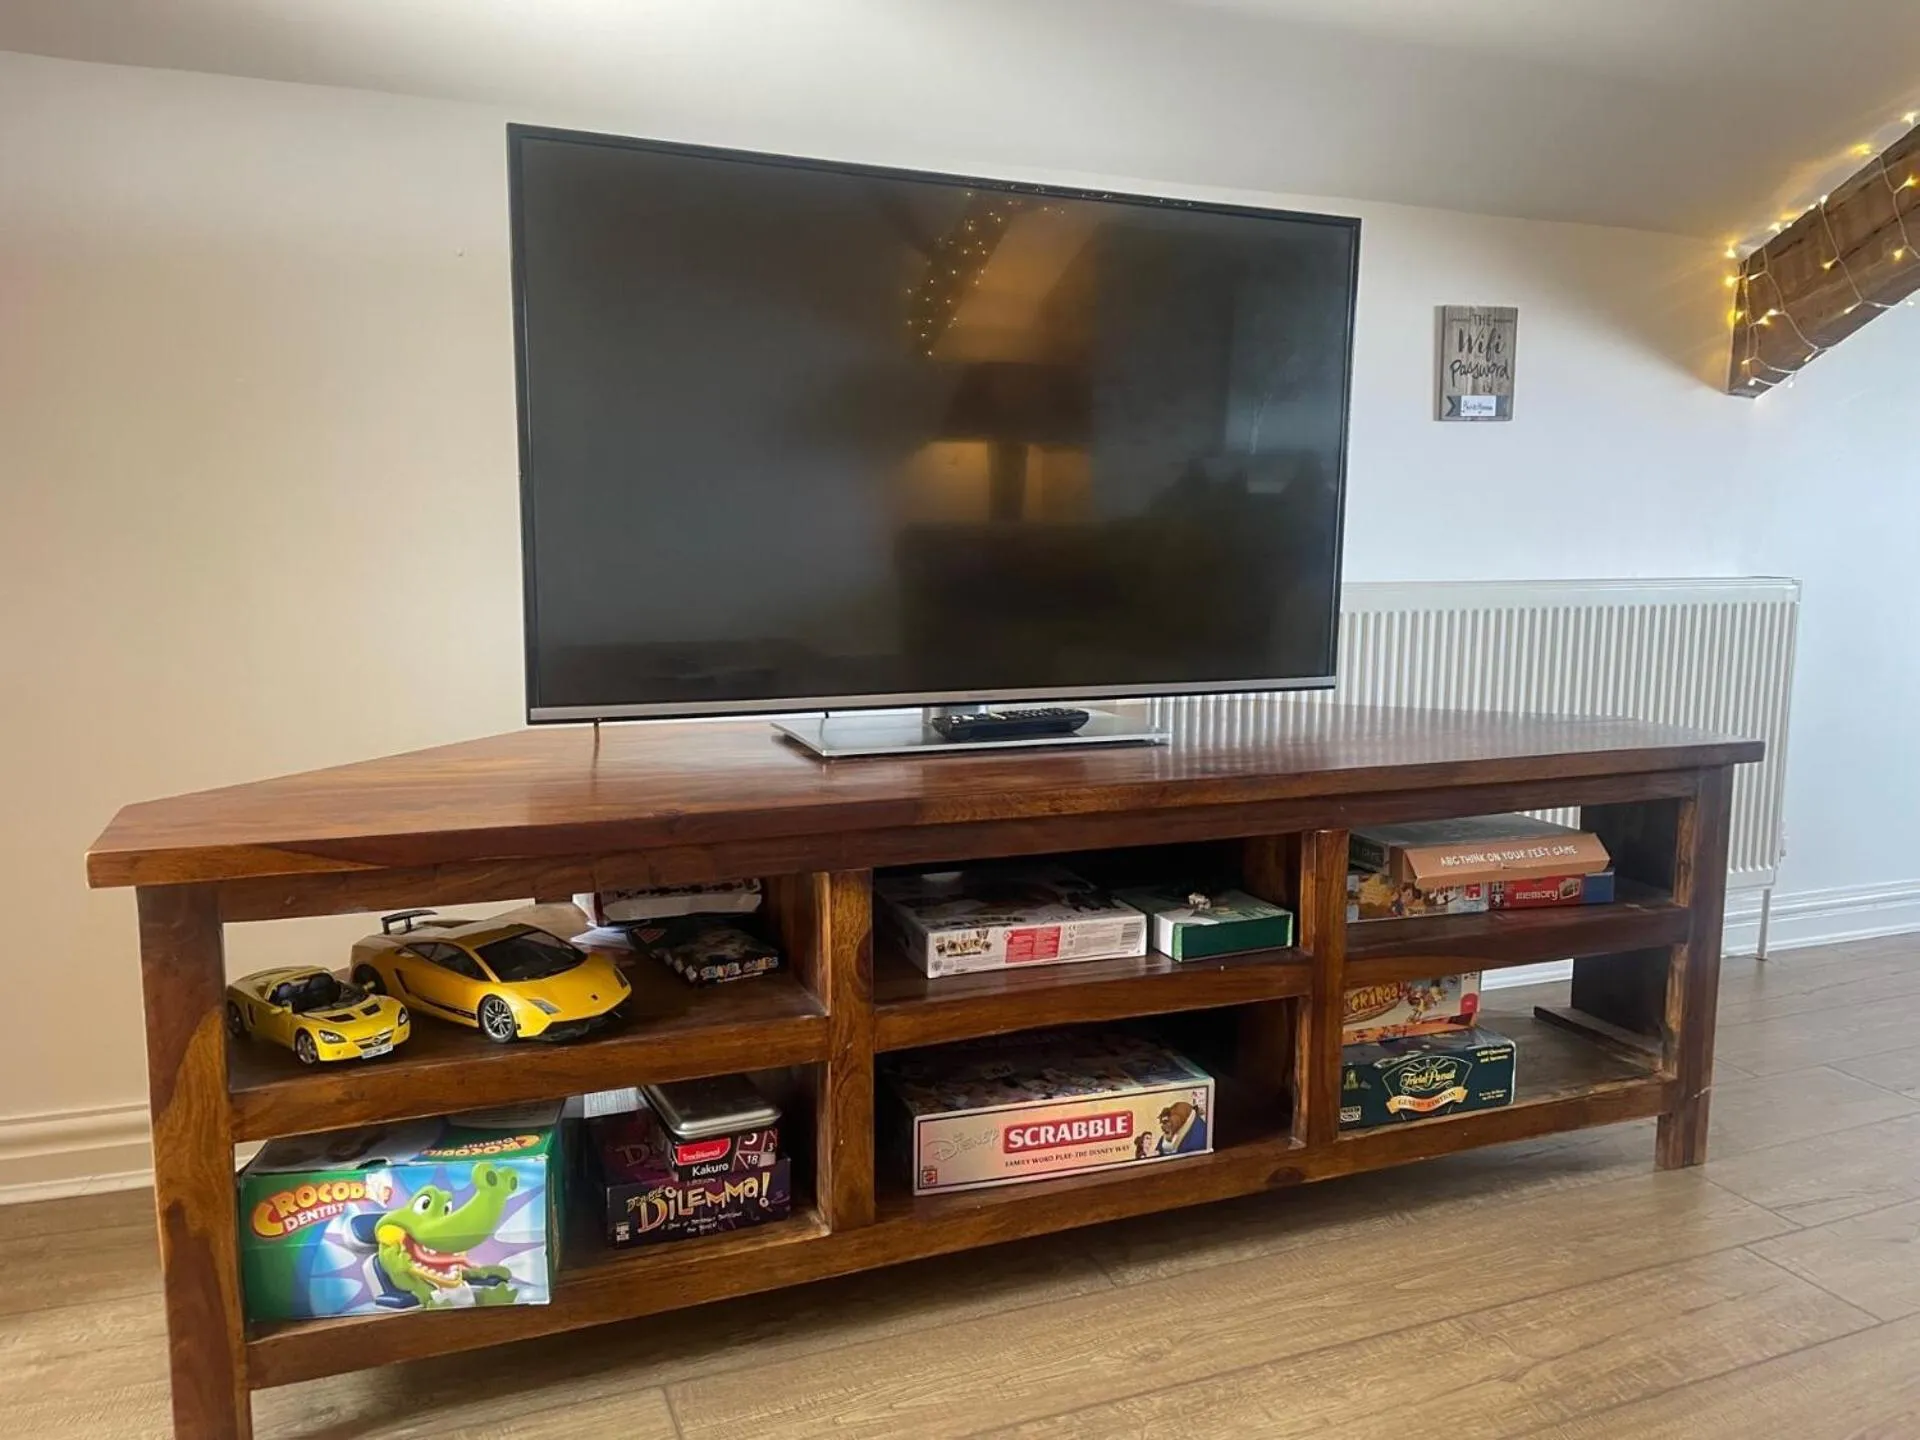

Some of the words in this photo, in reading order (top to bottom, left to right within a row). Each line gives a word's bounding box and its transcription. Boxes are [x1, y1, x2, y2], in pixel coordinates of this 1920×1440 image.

[1473, 314, 1492, 326] THE
[1458, 327, 1505, 362] Wifi
[1450, 359, 1510, 387] Password
[1460, 853, 1486, 864] THINK
[1486, 851, 1502, 862] ON
[1502, 849, 1526, 861] YOUR
[1527, 846, 1552, 858] FEET
[1552, 844, 1579, 857] GAME
[1515, 889, 1559, 901] memory
[1008, 1115, 1129, 1149] SCRABBLE
[682, 1147, 721, 1161] Traditional
[746, 1154, 758, 1165] 18
[1005, 1157, 1030, 1168] FAMILY
[1031, 1154, 1054, 1164] WORD
[1074, 1150, 1088, 1159] THE
[1088, 1147, 1114, 1157] DISNEY
[1115, 1145, 1130, 1153] WAY
[691, 1162, 729, 1177] Kakuro
[283, 1203, 344, 1233] DENTIST
